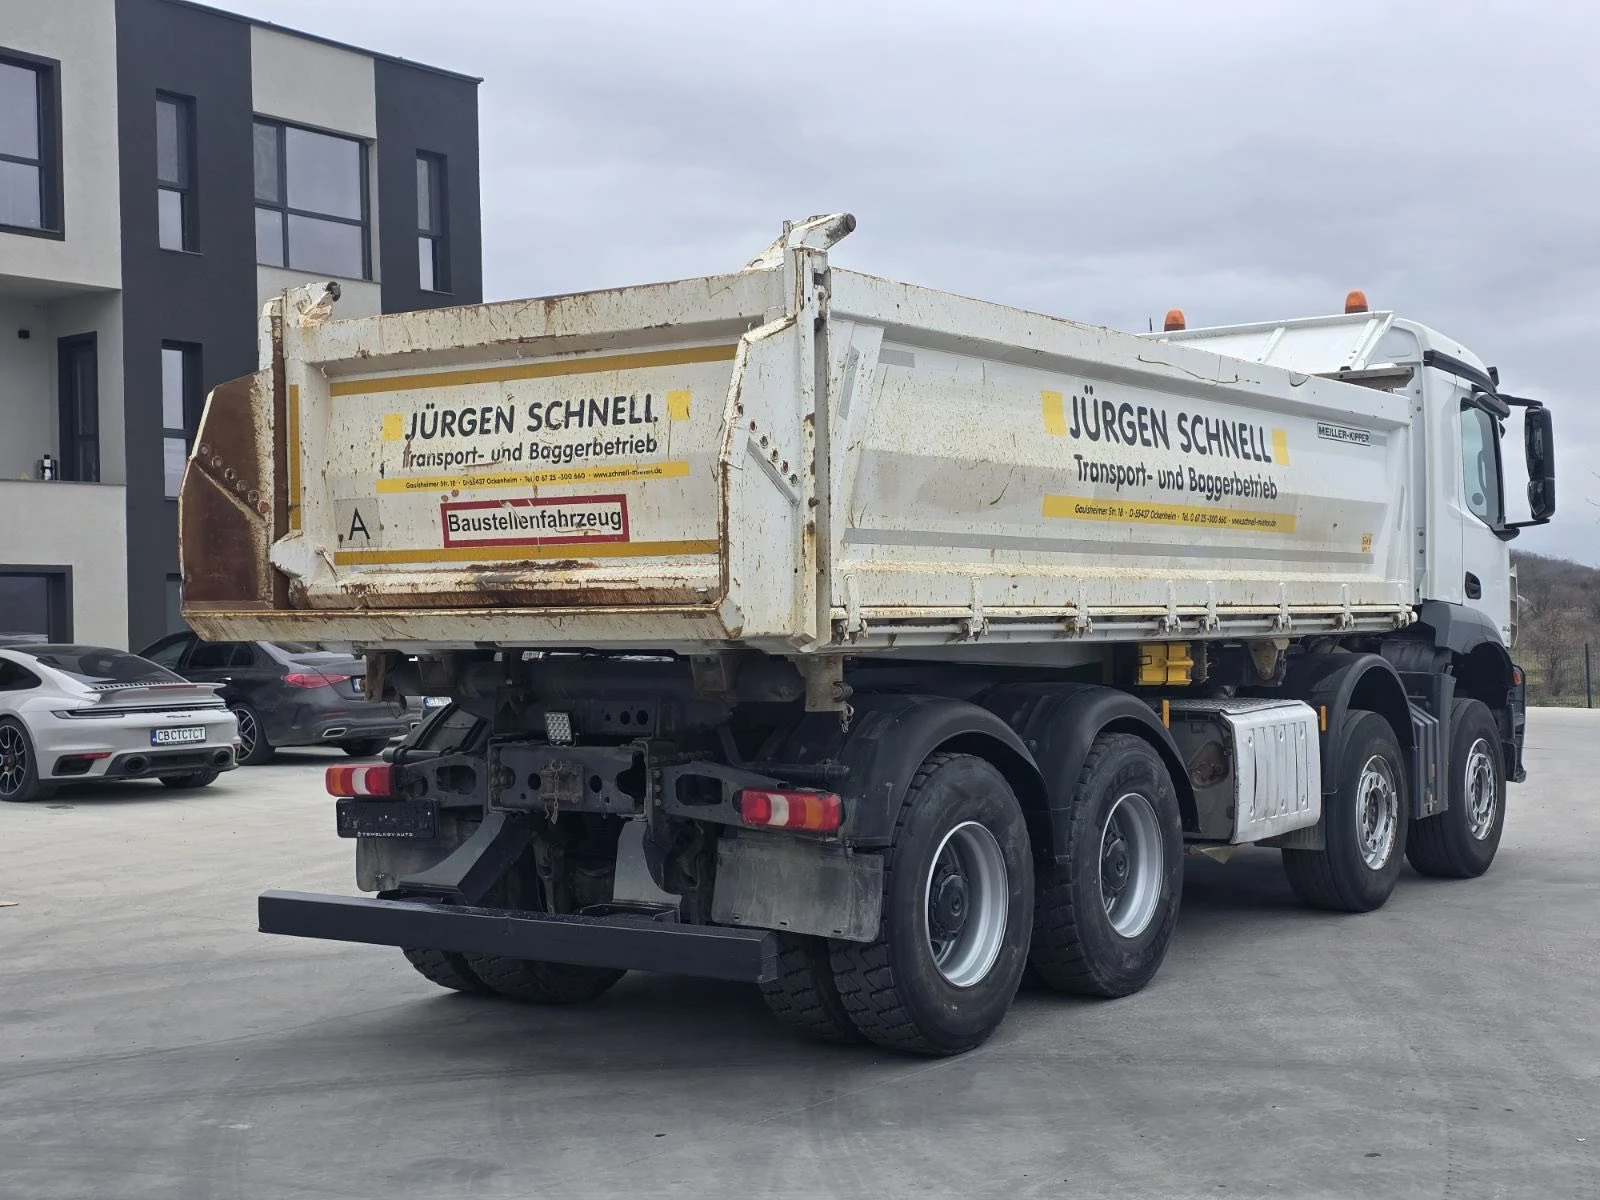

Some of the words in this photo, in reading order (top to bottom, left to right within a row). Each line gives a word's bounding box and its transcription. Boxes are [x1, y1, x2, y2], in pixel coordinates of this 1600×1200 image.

[405, 402, 515, 440] JÜRGEN
[527, 393, 659, 432] SCHNELL
[1070, 384, 1170, 451] JÜRGEN
[1177, 412, 1272, 464] SCHNELL
[491, 442, 523, 462] und
[529, 433, 658, 464] Baggerbetrieb
[1318, 426, 1370, 443] MEILLER-KIPPER
[406, 481, 439, 489] Gaulsheimer
[1073, 454, 1153, 493] Transport-
[1158, 464, 1184, 491] und
[1188, 466, 1278, 502] Baggerbetrieb
[348, 508, 371, 541] A
[448, 508, 622, 533] Baustellenfahrzeug
[1074, 504, 1108, 516] Gaulsheimer
